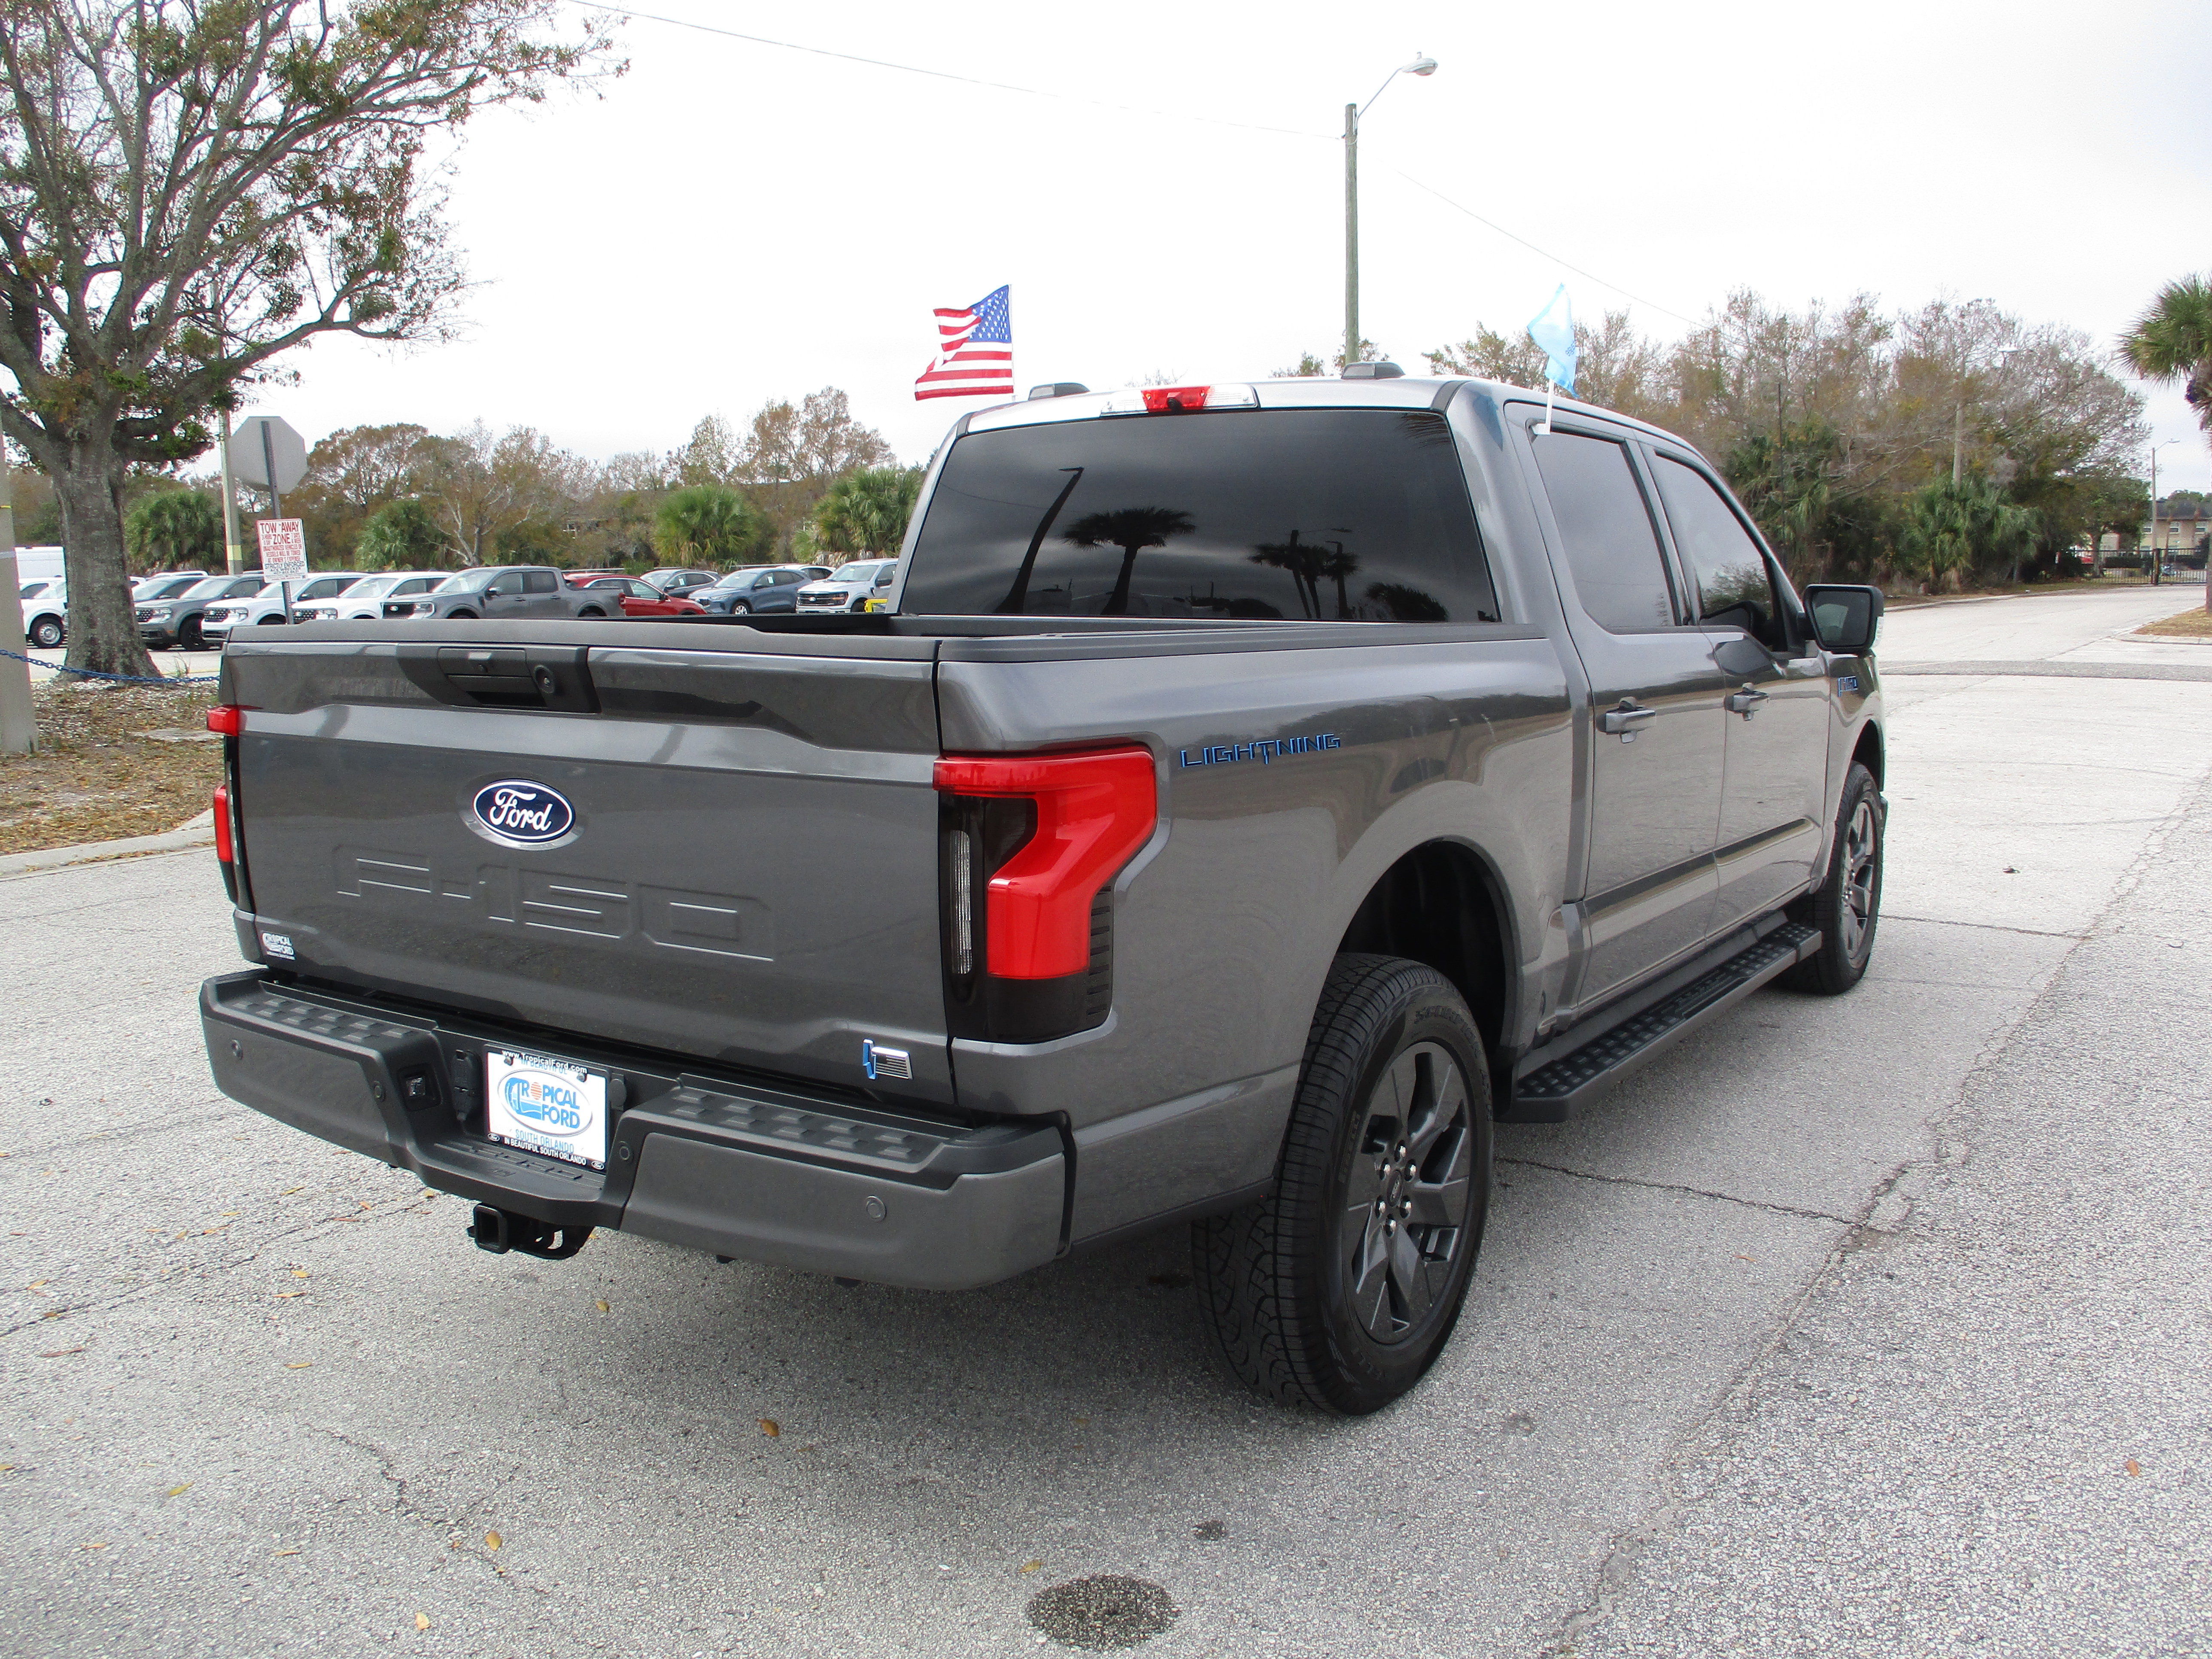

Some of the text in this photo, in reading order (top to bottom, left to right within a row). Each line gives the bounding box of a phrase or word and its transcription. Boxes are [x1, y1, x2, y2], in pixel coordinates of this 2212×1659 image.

[260, 521, 299, 533] TOW AWAY
[273, 533, 291, 544] ZONE
[1181, 733, 1341, 768] LIGHTNING
[489, 789, 553, 831] Ford
[502, 1050, 587, 1074] www.TropicalFord.com
[505, 1077, 580, 1113] TROPICAL
[542, 1104, 580, 1129] FORD
[511, 1138, 539, 1153] BEAUTIFUL
[540, 1147, 559, 1158] SOUTH
[559, 1152, 586, 1165] ORLANDO
[515, 1129, 574, 1153] SOUTH ORLANDO
